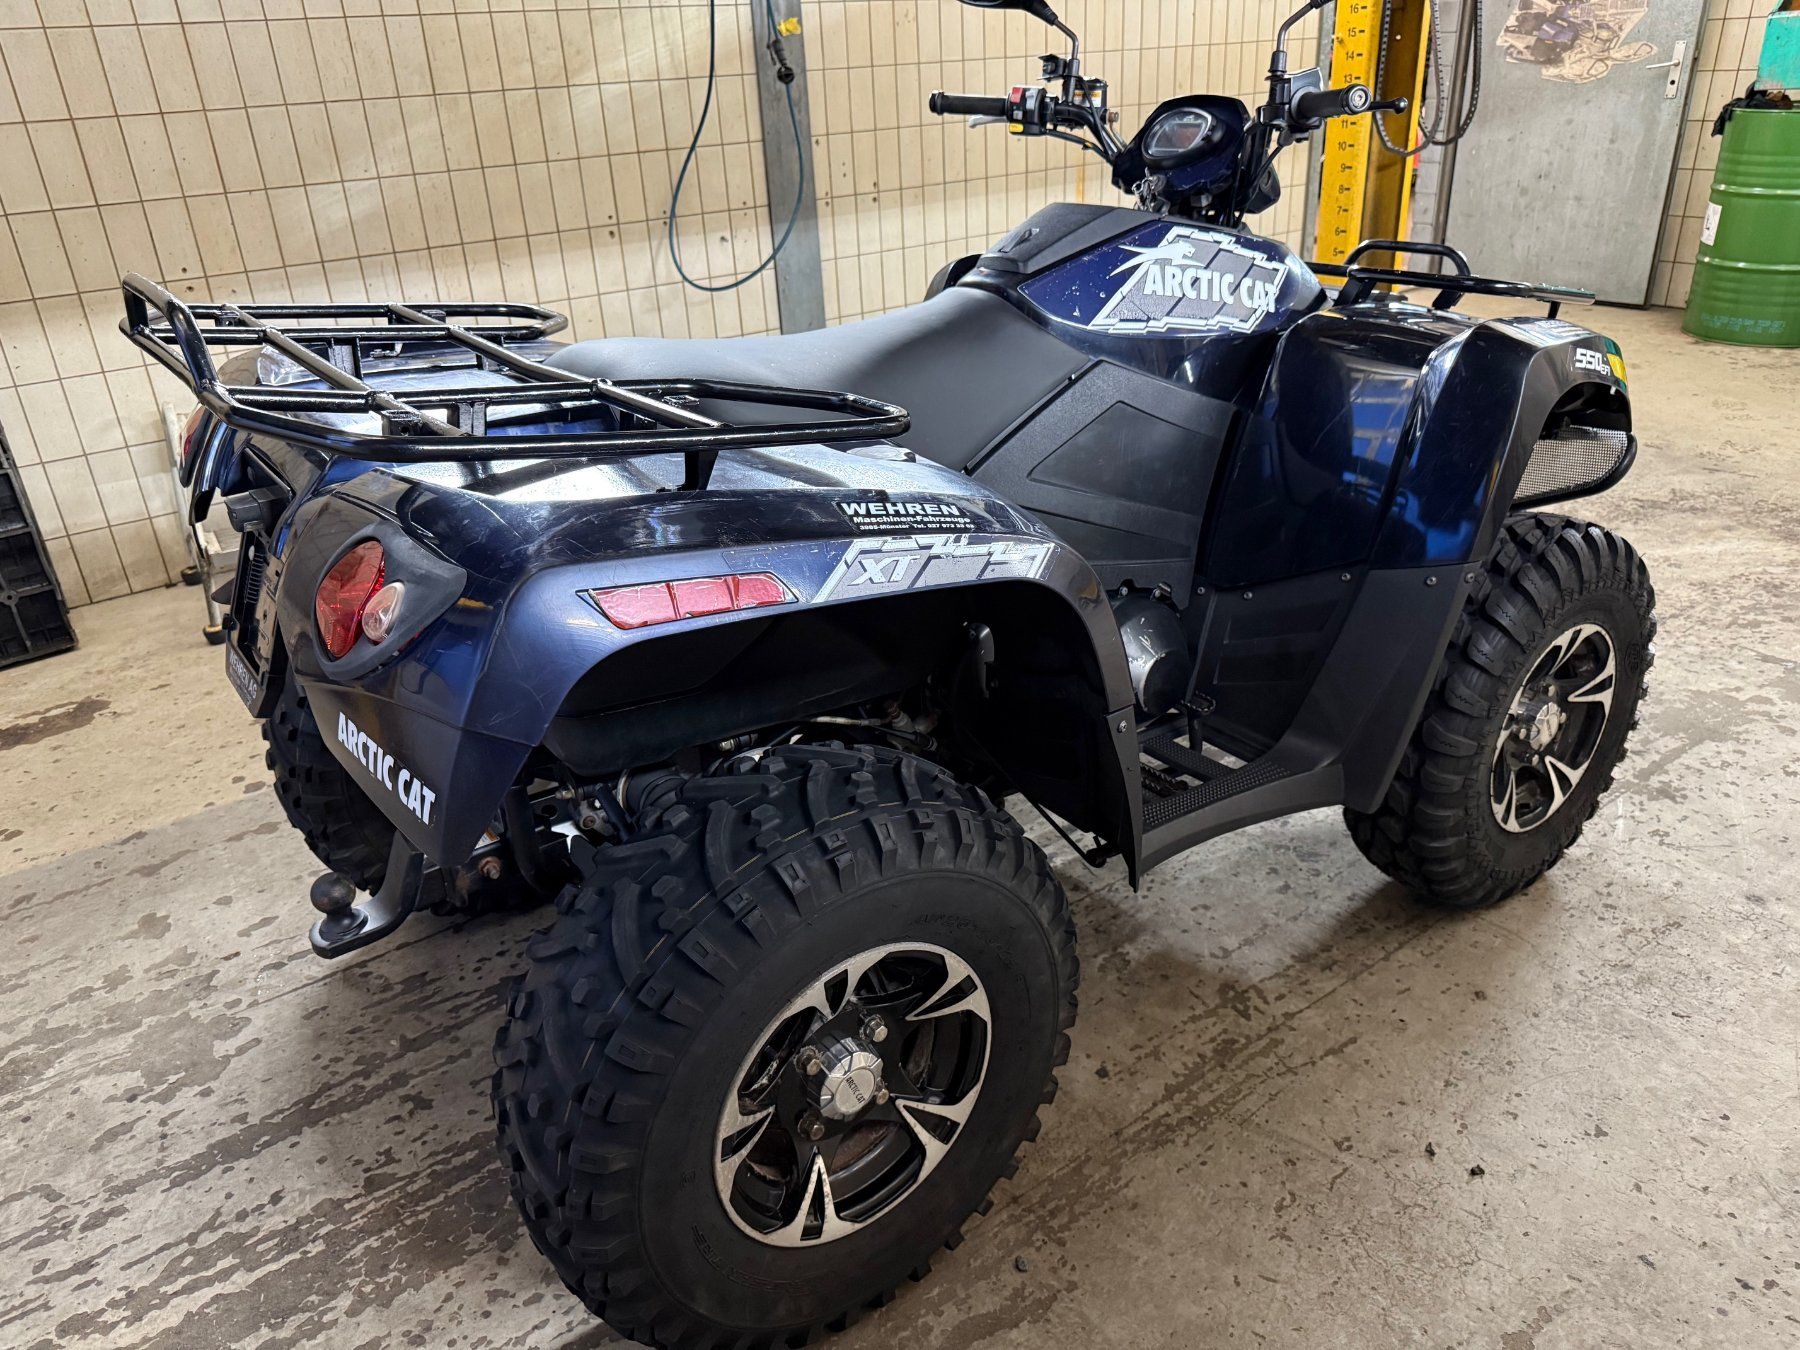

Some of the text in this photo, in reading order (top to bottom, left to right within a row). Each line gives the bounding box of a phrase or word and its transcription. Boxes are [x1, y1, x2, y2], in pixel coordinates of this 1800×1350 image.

[1350, 4, 1359, 14] 16
[1347, 27, 1357, 38] 15
[1345, 50, 1355, 61] 14
[1343, 74, 1353, 84] 13
[1341, 119, 1348, 129] 11
[1338, 141, 1347, 151] 10
[1340, 163, 1346, 173] 9
[1338, 184, 1344, 194] 8
[1336, 206, 1342, 215] 7
[1334, 226, 1340, 236] 6
[1332, 247, 1338, 257] 5
[1143, 264, 1277, 313] ARCTIC CAT
[1575, 347, 1603, 371] 550
[840, 502, 961, 516] WEHREN
[852, 515, 971, 524] Maschinen-Fahrzeuge
[847, 555, 920, 586] XT
[338, 711, 436, 825] ARCTIC CAT
[845, 1076, 866, 1104] ARCTIC CAT
